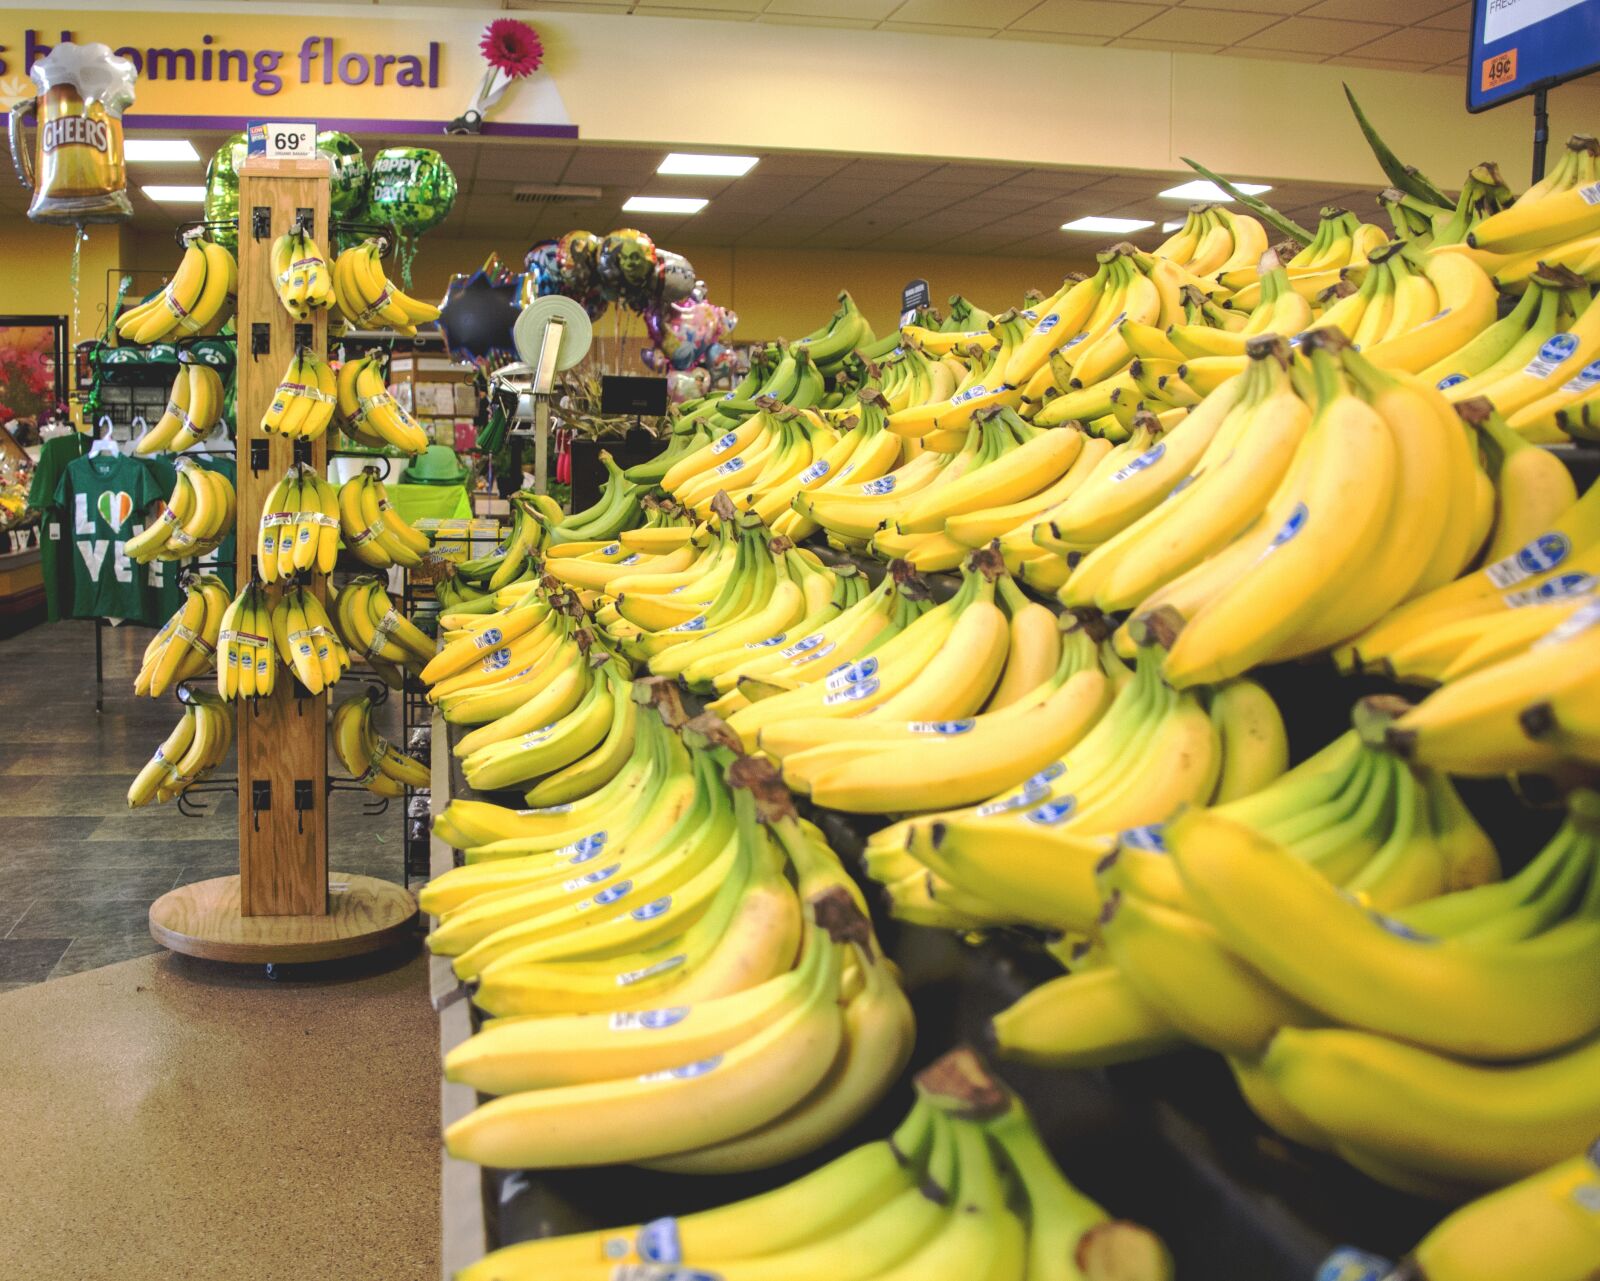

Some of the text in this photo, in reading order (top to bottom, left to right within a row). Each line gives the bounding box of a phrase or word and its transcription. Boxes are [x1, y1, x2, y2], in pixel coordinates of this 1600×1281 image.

[1489, 0, 1521, 14] FRE
[25, 28, 283, 97] boming
[298, 35, 439, 88] floral
[1489, 58, 1512, 80] 49¢
[43, 117, 107, 152] CHEERS
